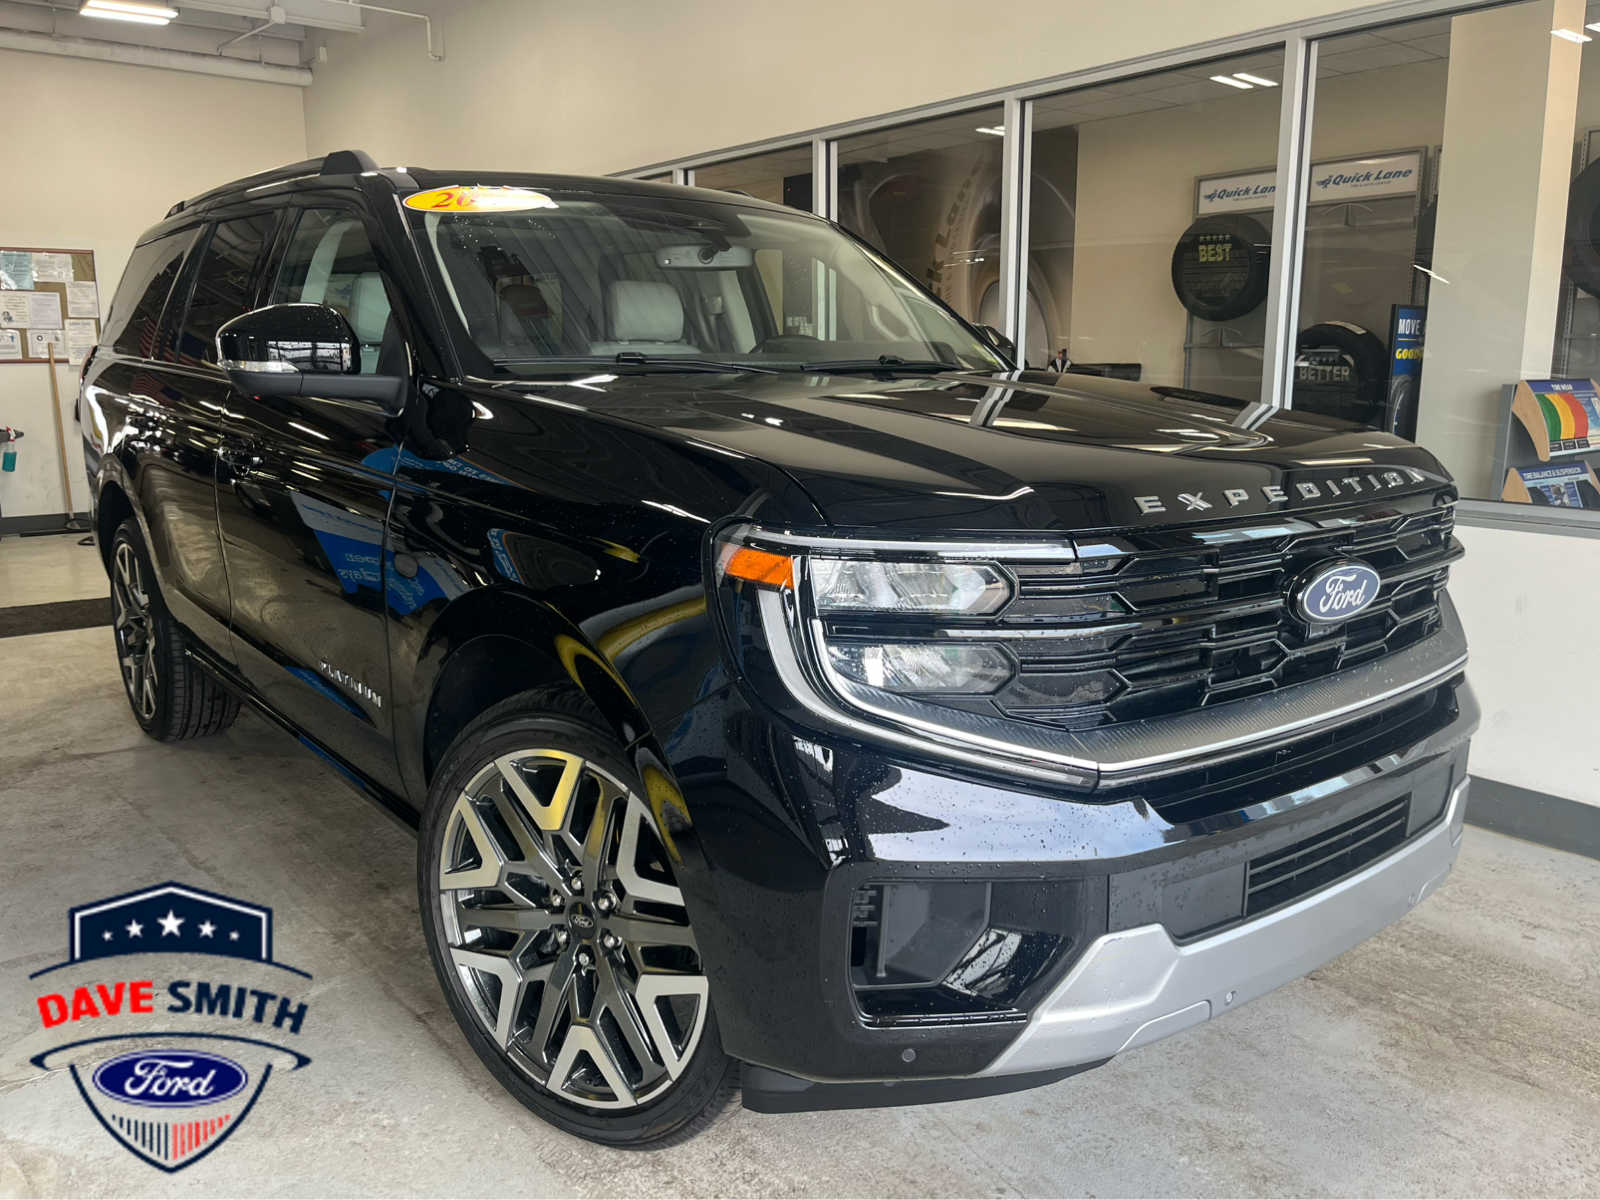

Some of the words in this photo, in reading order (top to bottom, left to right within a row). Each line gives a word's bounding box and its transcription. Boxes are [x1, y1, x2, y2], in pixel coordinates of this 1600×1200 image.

[1332, 171, 1374, 186] Quick
[1375, 169, 1412, 180] Lane
[1217, 186, 1251, 200] Quick
[1253, 184, 1276, 195] Lan
[1199, 244, 1232, 262] BEST
[1398, 318, 1420, 335] MOVE
[1298, 365, 1350, 381] BETTER
[1134, 469, 1425, 514] EXPEDITION
[1319, 573, 1365, 613] Ford
